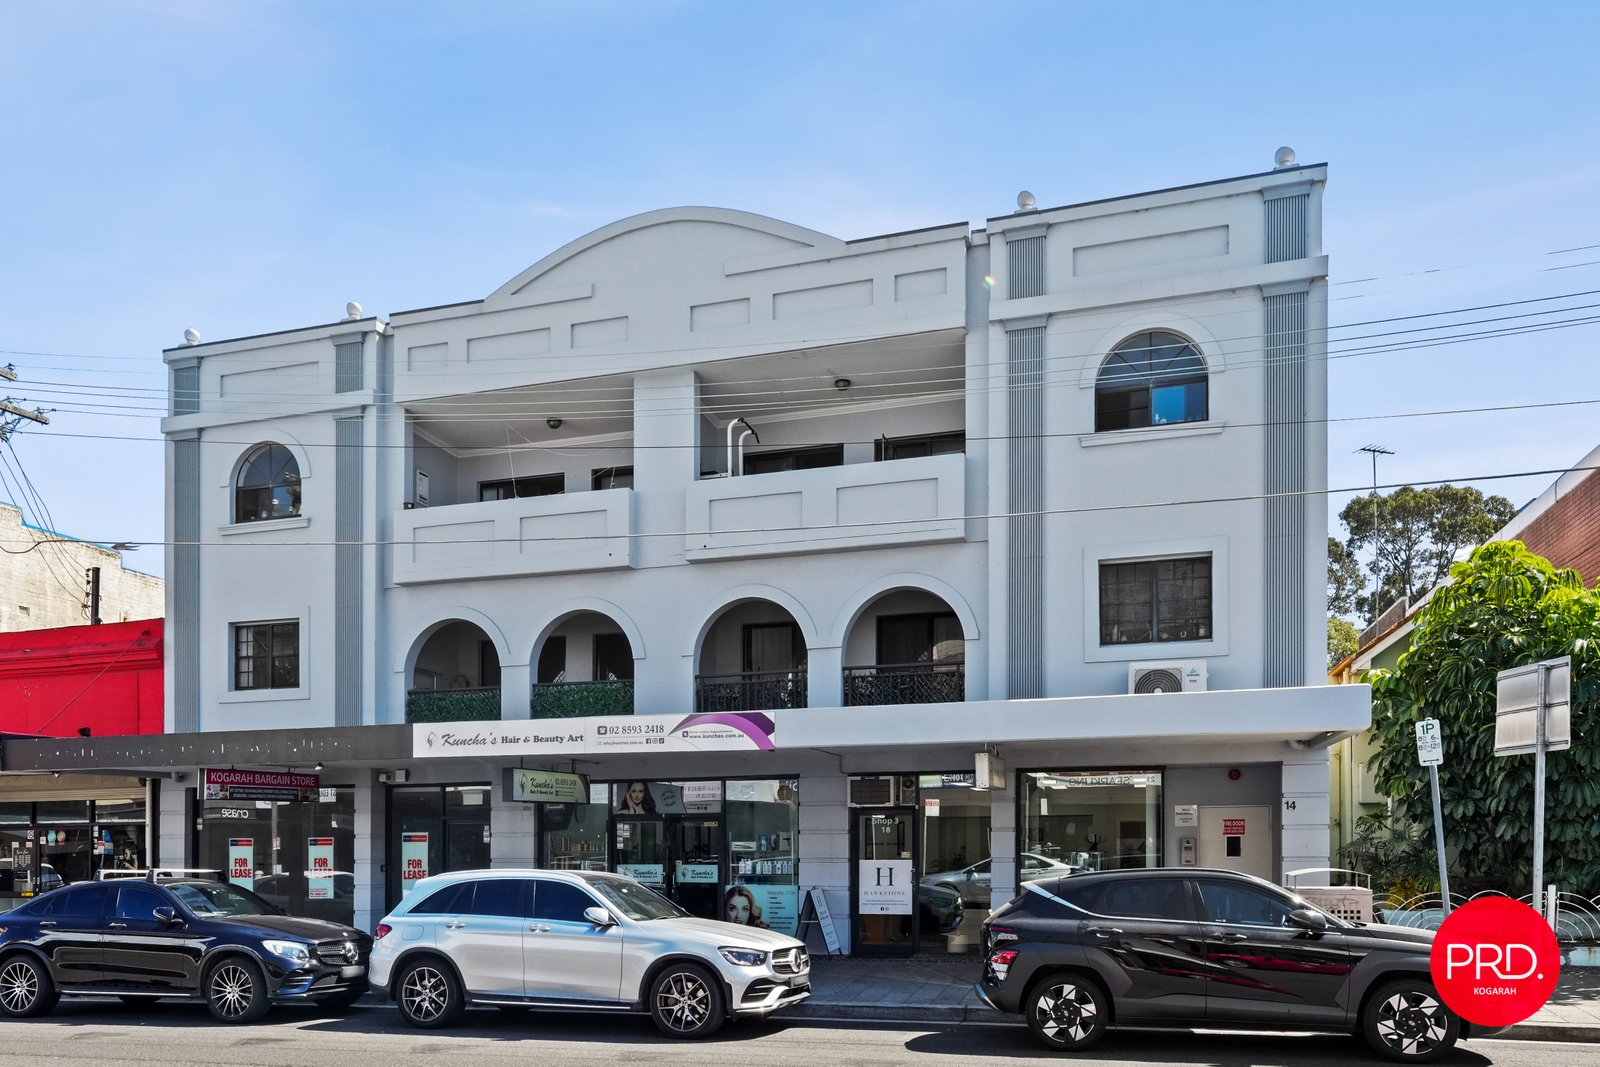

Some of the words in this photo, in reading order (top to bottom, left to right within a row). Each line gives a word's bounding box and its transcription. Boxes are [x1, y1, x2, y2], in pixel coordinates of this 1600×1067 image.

[609, 726, 620, 734] 02
[622, 725, 642, 734] 8593
[644, 724, 664, 734] 2418
[1421, 723, 1434, 734] 1P
[441, 732, 497, 746] Kuncha's
[501, 736, 520, 744] Hair
[533, 735, 564, 744] Beauty
[567, 734, 584, 742] Art
[211, 772, 253, 782] KOGARAH
[254, 774, 290, 784] BARGAIN
[291, 776, 315, 786] STORE
[1284, 801, 1296, 810] 14
[234, 858, 248, 867] FOR
[314, 858, 328, 867] FOR
[408, 859, 422, 869] FOR
[230, 868, 252, 878] LEASE
[404, 870, 426, 880] LEASE
[875, 867, 894, 886] H
